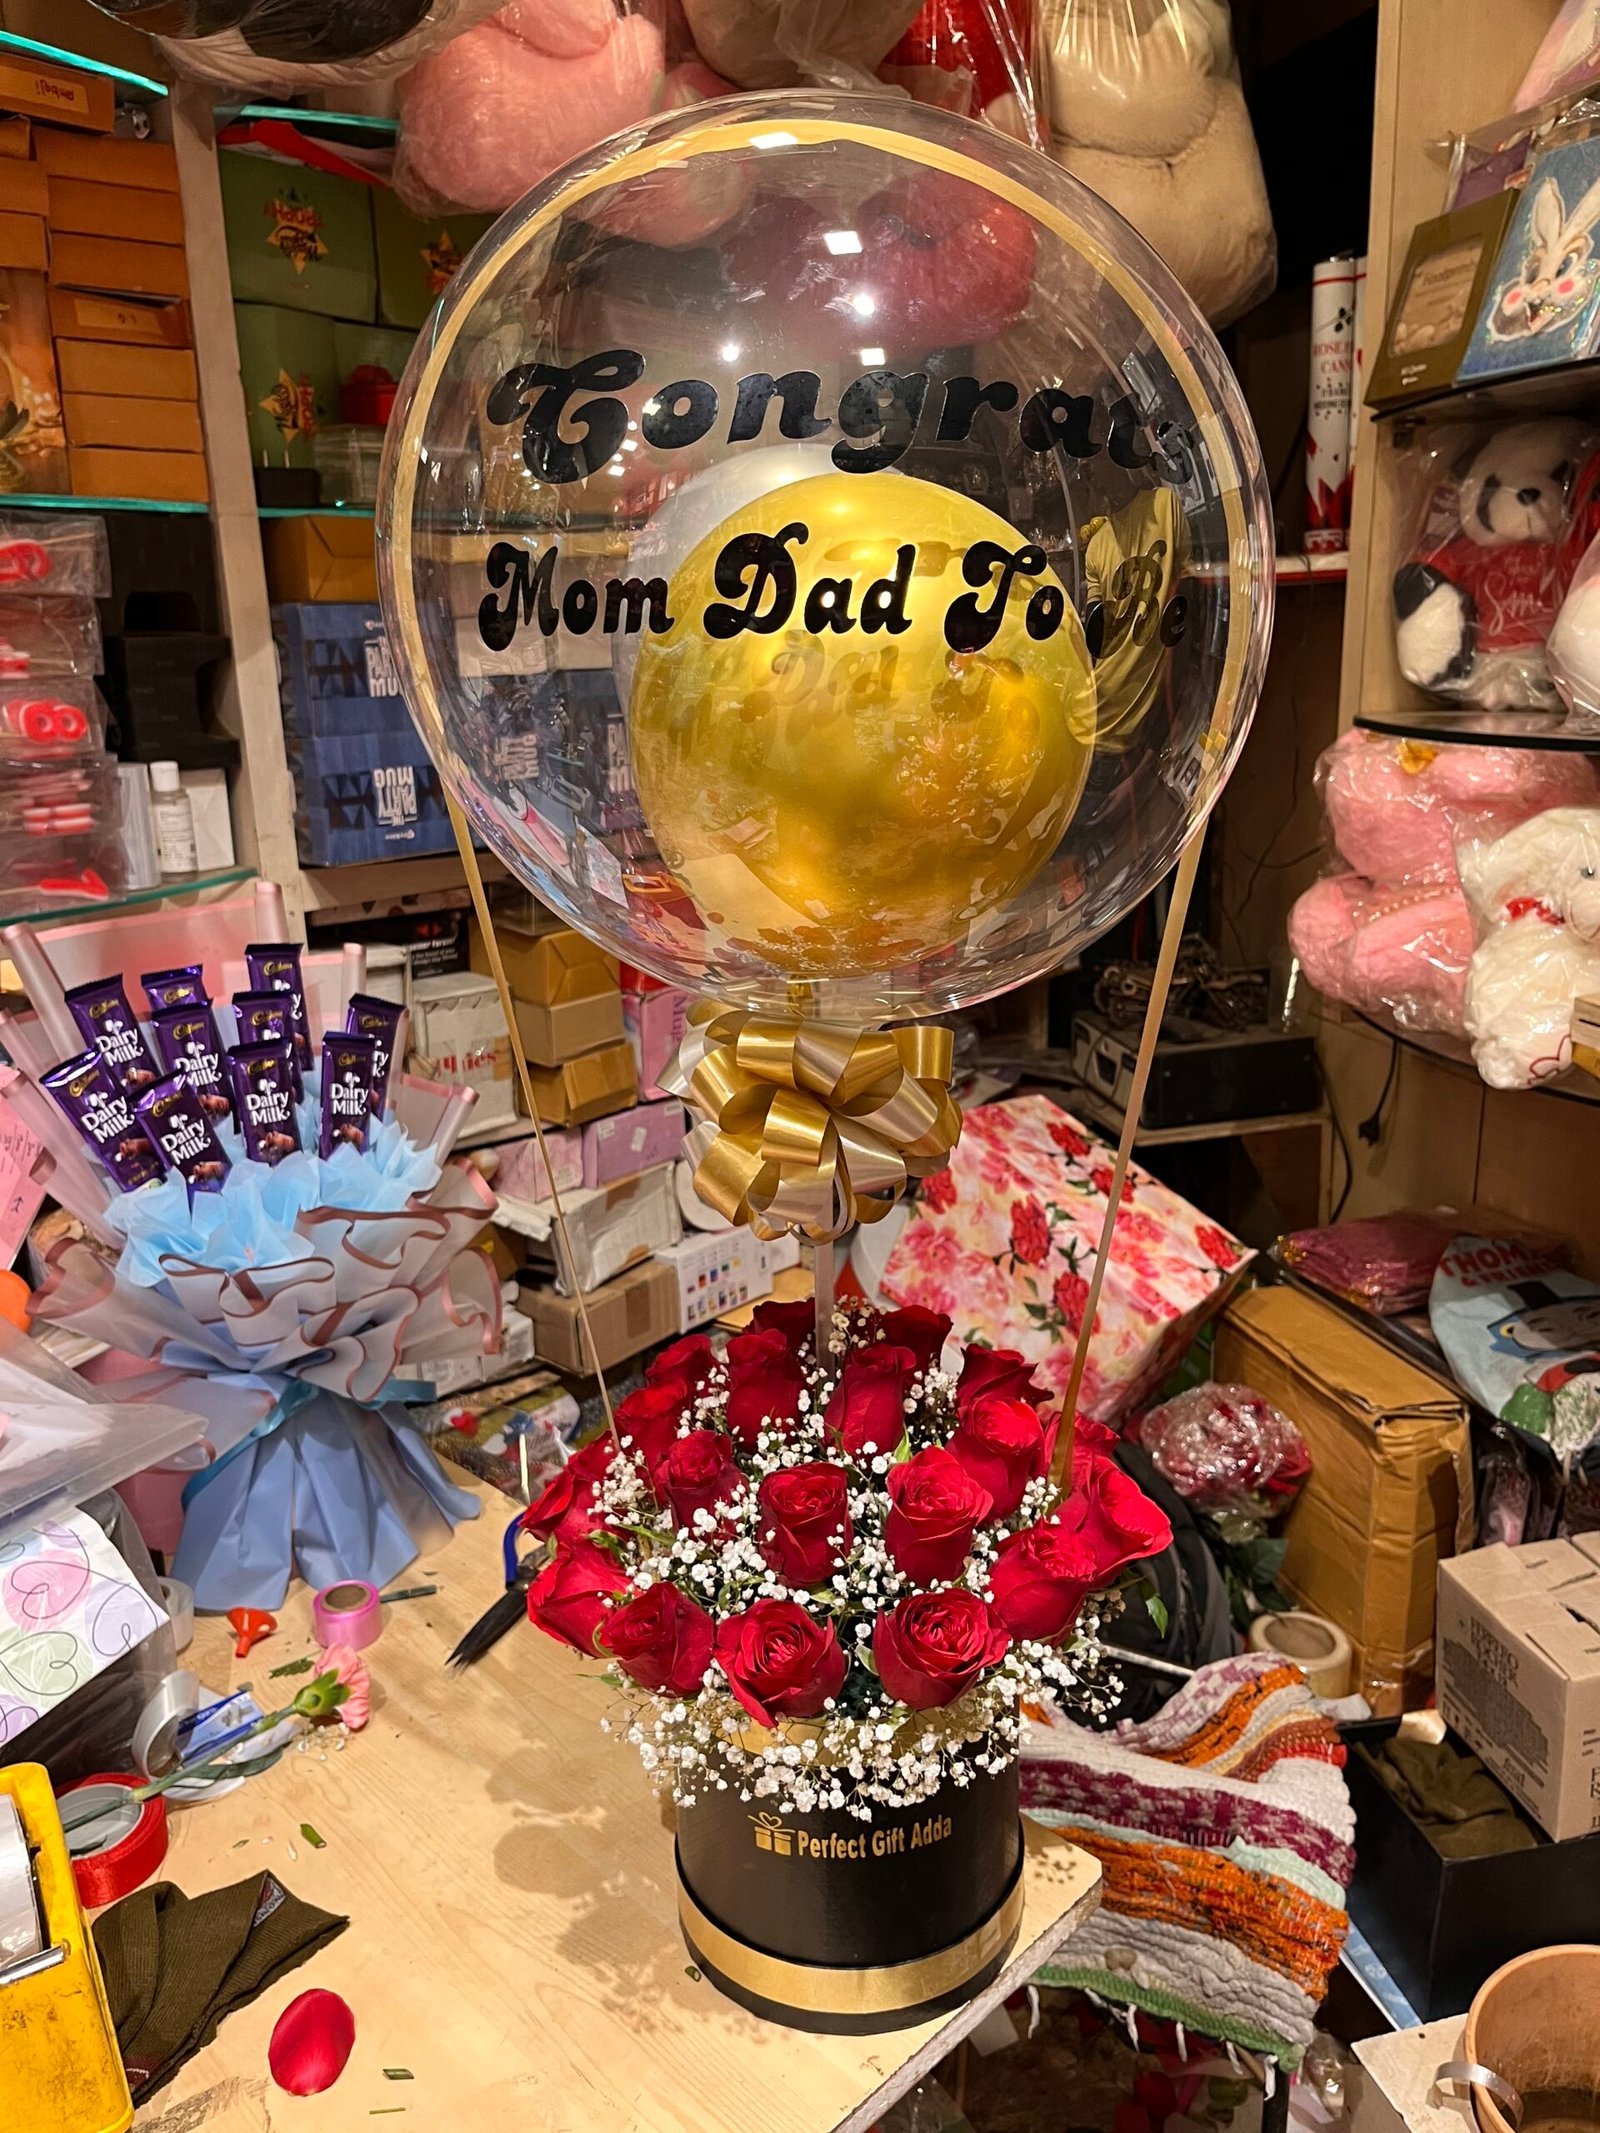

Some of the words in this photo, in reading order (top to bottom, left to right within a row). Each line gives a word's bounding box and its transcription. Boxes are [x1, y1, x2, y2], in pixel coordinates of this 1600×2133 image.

[480, 541, 675, 652] Mom
[703, 521, 917, 640] Dad
[943, 540, 1065, 654] To
[1085, 539, 1188, 660] Be
[95, 1028, 138, 1053] Dairy
[103, 1045, 145, 1067] Milk
[174, 1053, 219, 1072] Dairy
[187, 1067, 223, 1087] Milk
[246, 1091, 289, 1111] Dairy
[330, 1083, 369, 1102] Dairy
[81, 1096, 128, 1131] Dairy
[251, 1107, 291, 1126] Milk
[332, 1100, 367, 1116] Milk
[93, 1114, 136, 1144] Milk
[161, 1119, 206, 1153] Dairy
[171, 1137, 212, 1165] Milk
[797, 1830, 867, 1860] Perfect
[871, 1827, 905, 1857] Gift
[910, 1814, 953, 1850] Adda
